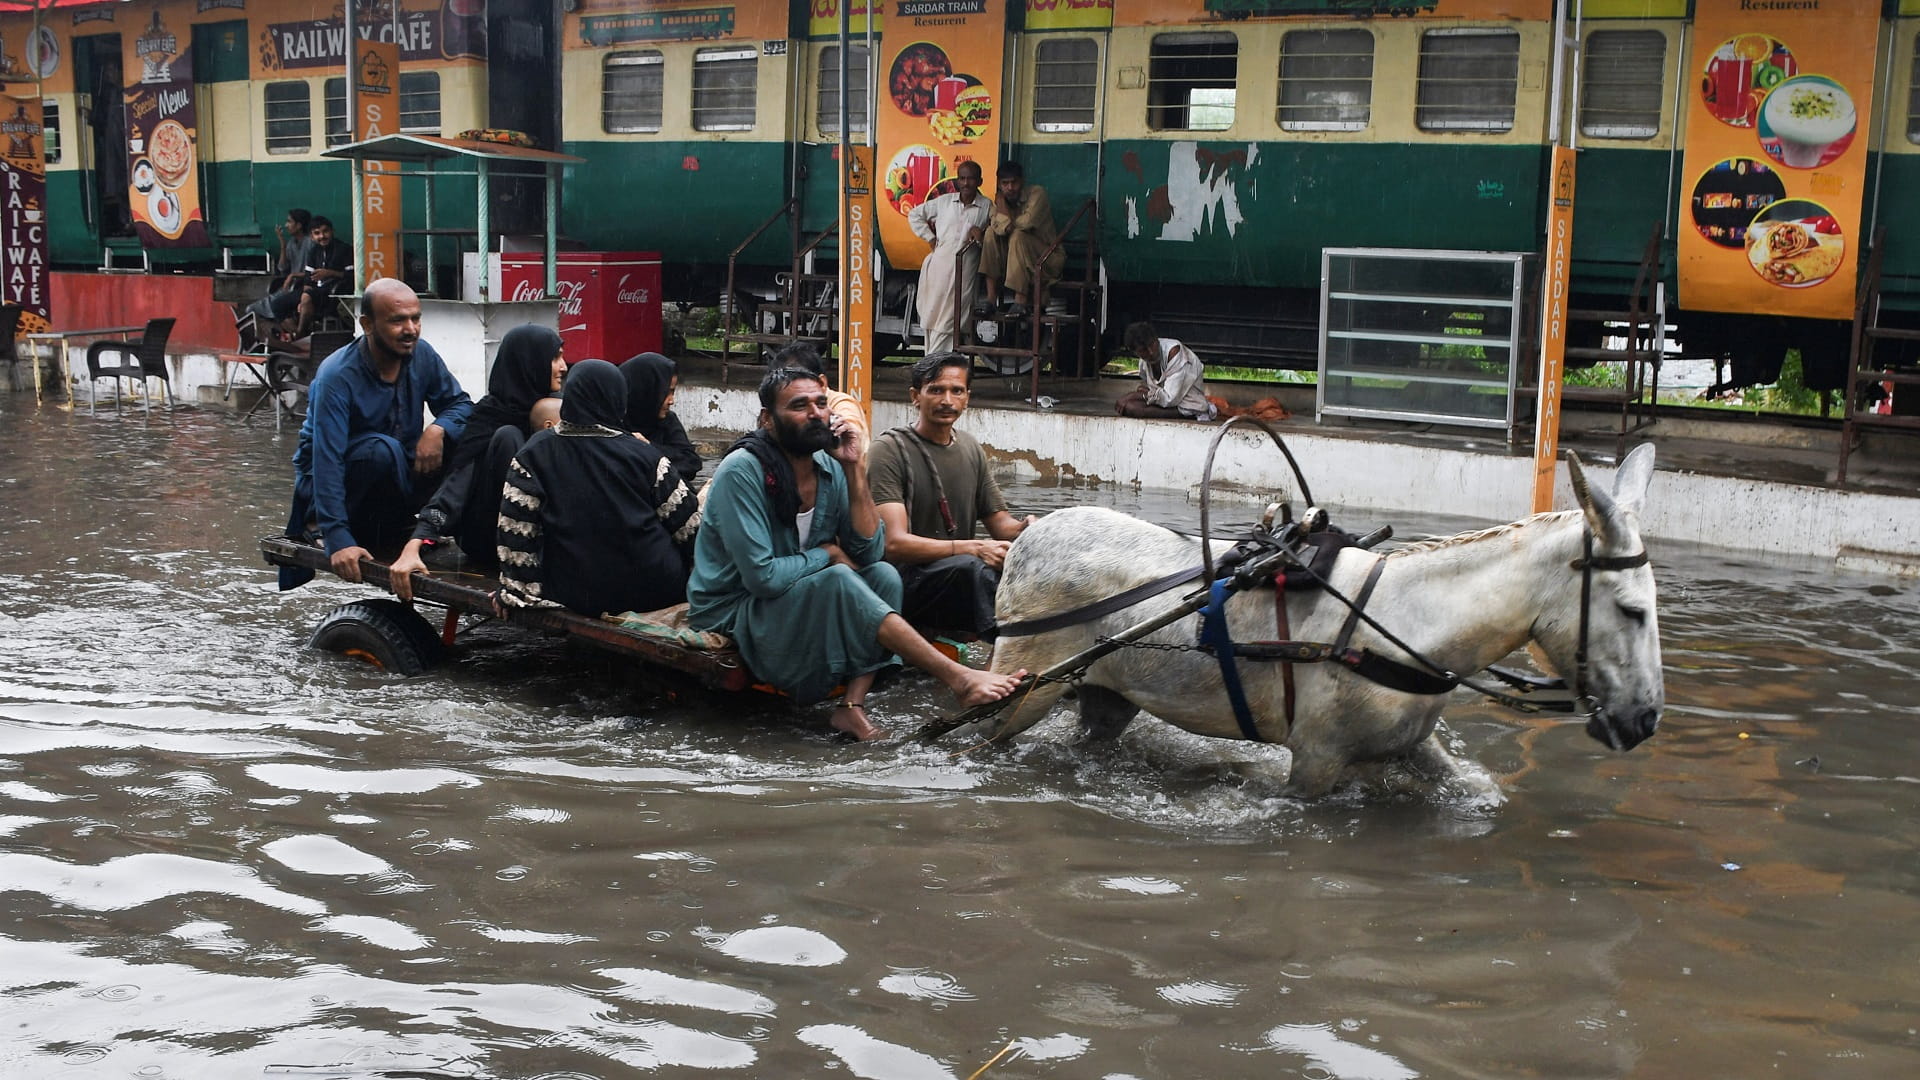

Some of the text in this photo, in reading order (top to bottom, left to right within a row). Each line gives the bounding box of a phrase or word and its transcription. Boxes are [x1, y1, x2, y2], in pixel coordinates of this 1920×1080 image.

[283, 20, 432, 60] RAILWY CAFE
[904, 1, 978, 14] SARDAR TRAIN
[914, 16, 966, 26] Resturent
[1741, 0, 1820, 10] Resturent
[132, 88, 190, 119] Special Menu
[366, 104, 384, 214] SADAR
[8, 172, 25, 303] RAILWAY
[28, 226, 43, 305] CAFÉ
[368, 233, 384, 284] TRA
[850, 205, 863, 305] SARDAR
[1551, 219, 1565, 339] SARDAR
[850, 322, 863, 402] TRAIN
[1543, 360, 1556, 458] TRAIN
